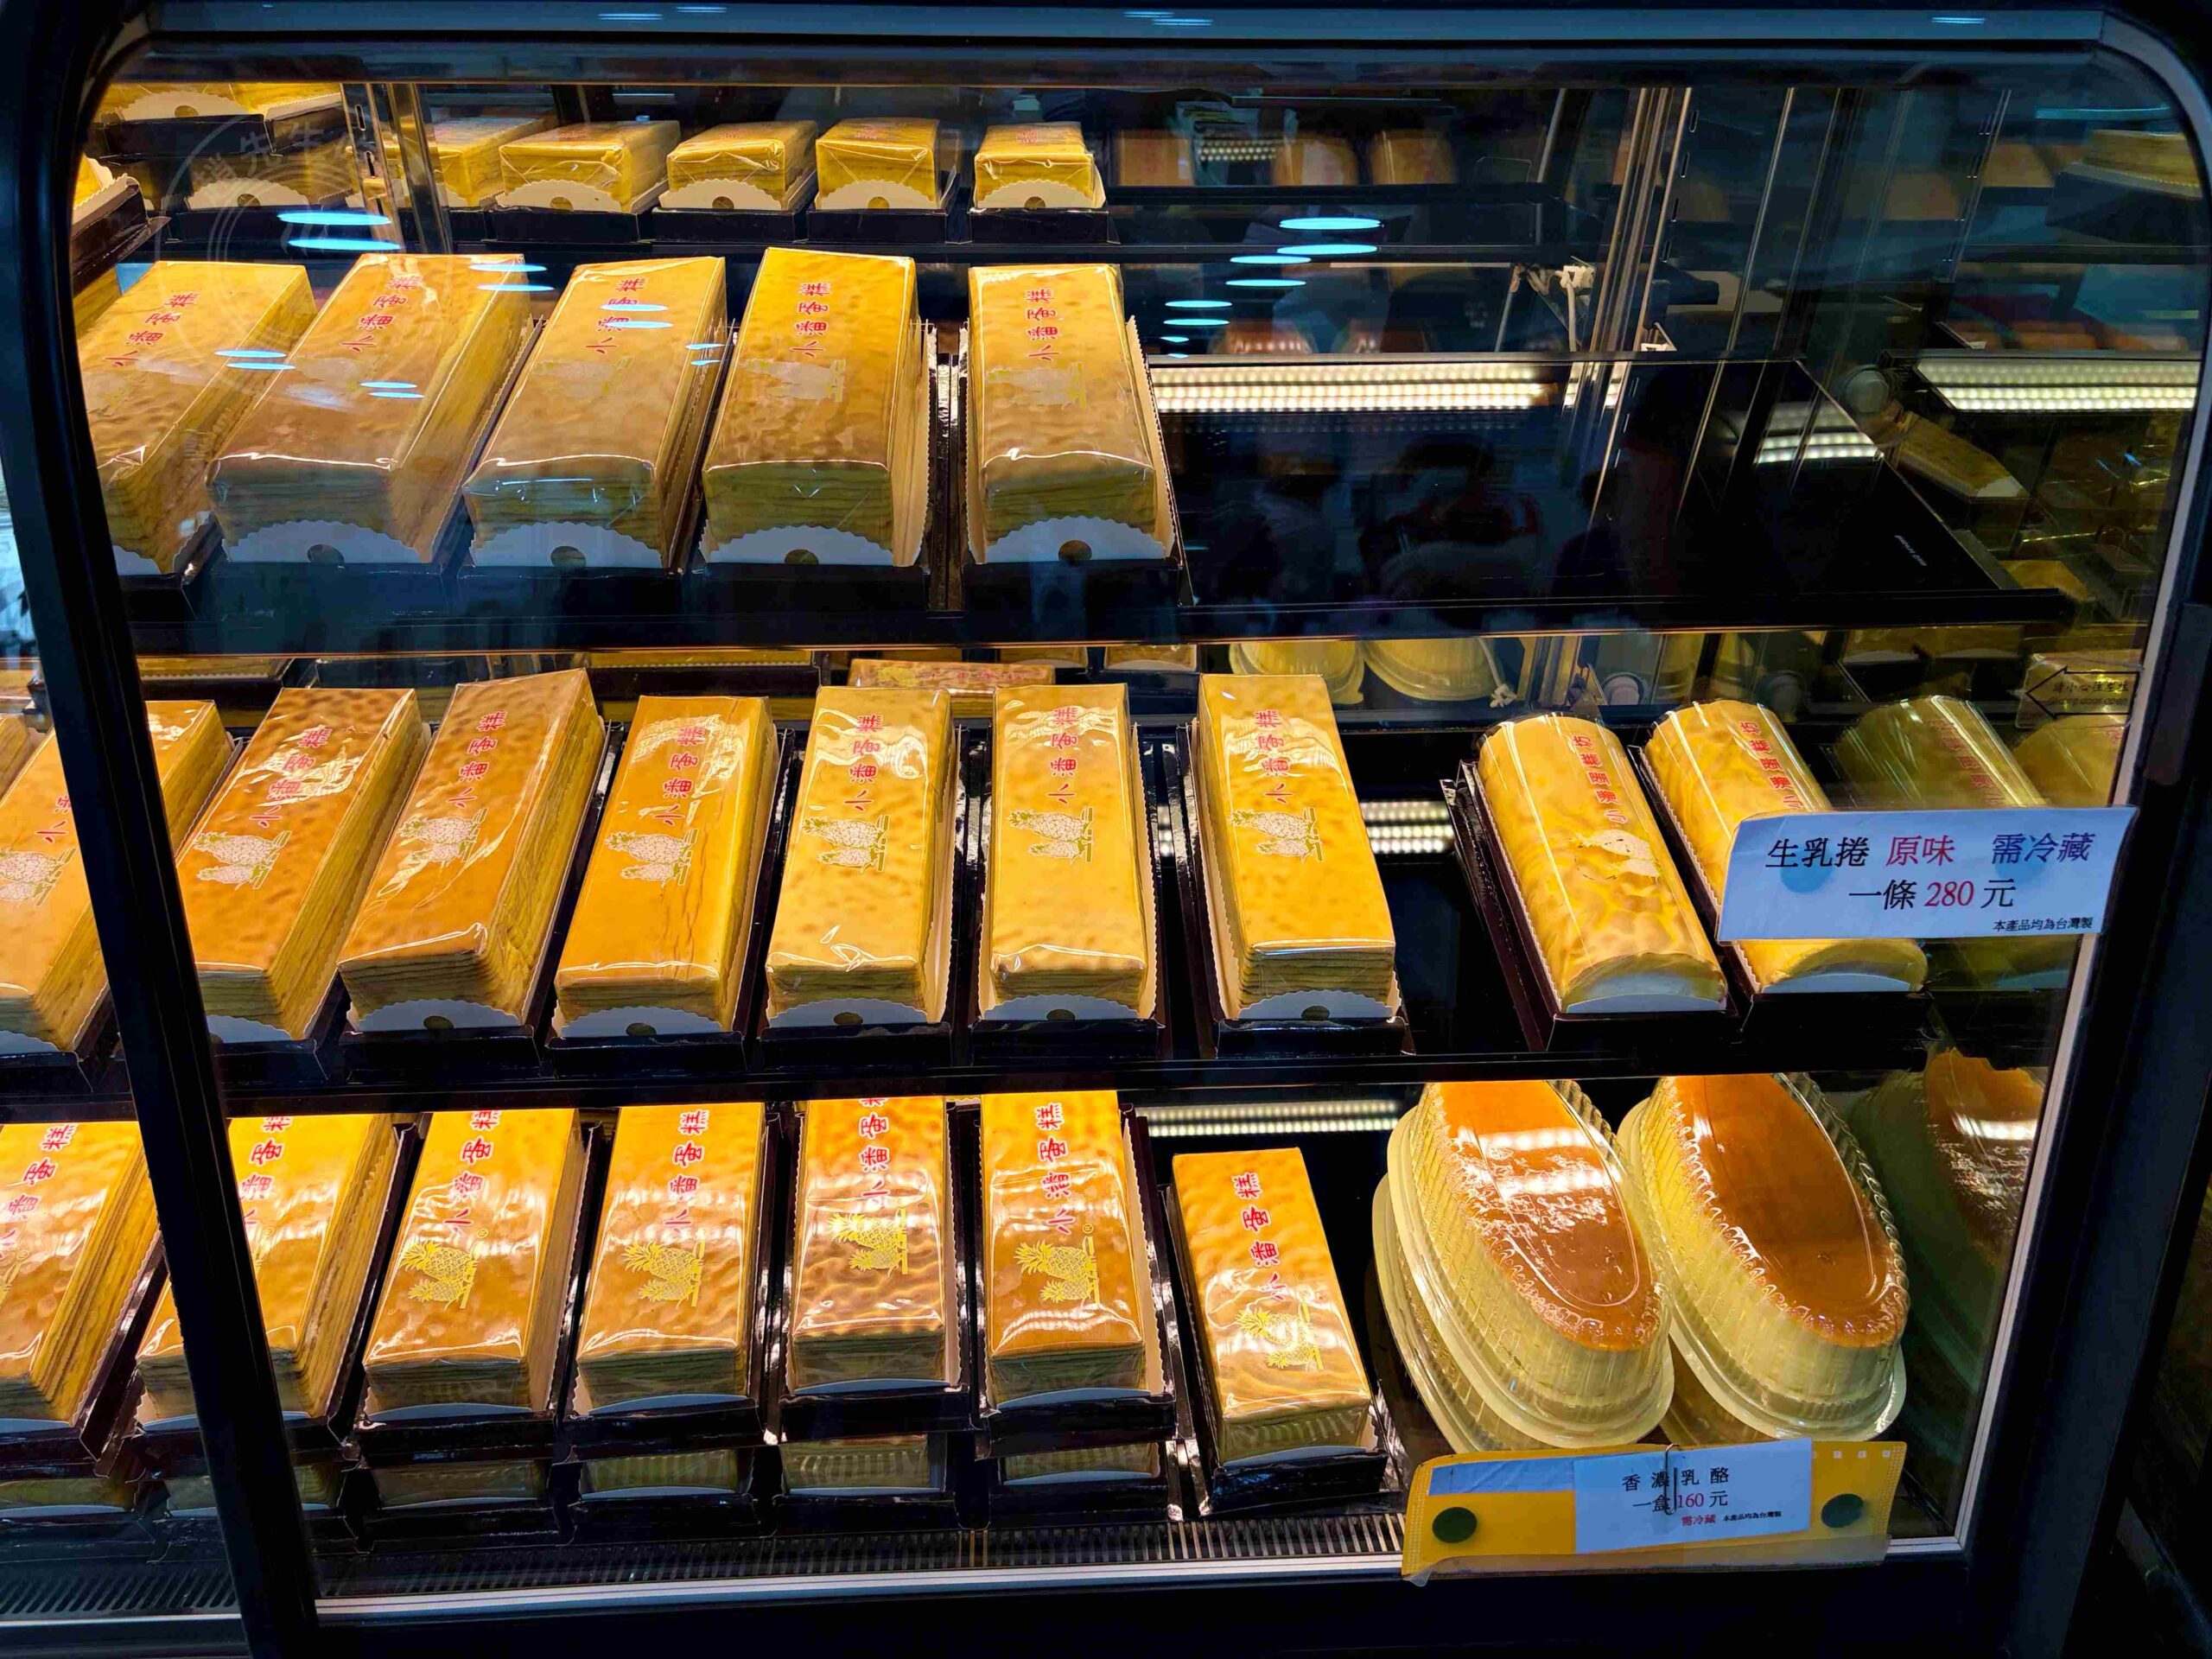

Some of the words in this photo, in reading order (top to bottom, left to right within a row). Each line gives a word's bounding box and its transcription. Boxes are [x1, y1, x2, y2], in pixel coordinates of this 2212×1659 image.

[105, 291, 200, 367] 小潘蛋糕
[340, 274, 423, 352] 小潘蛋糕
[790, 281, 831, 358] 小潘蛋糕
[1025, 287, 1059, 361] 小潘蛋糕
[250, 724, 333, 829] 小潘蛋糕
[447, 709, 507, 809] 小潘蛋糕
[652, 726, 706, 826] 小潘蛋糕
[842, 715, 885, 812] 小潘蛋糕
[1047, 706, 1079, 805] 小潘蛋糕
[1255, 709, 1294, 804] 小潘蛋糕
[1571, 734, 1628, 824] 小潘蛋糕坊
[1740, 720, 1804, 809] 小潘蛋糕坊
[1764, 836, 1870, 868] 生乳捲
[1885, 834, 1955, 867] 原味
[1991, 832, 2096, 865] 需冷藏
[1848, 880, 1916, 910] 一條
[1923, 880, 1974, 907] 280
[1981, 879, 2017, 909] 元
[1993, 917, 2093, 932] 本產品均為台灣製
[664, 1109, 709, 1236] 小潘蛋糕
[1035, 1103, 1076, 1234] 小潘蛋糕
[1234, 1172, 1287, 1300] 小潘蛋糕
[1677, 1492, 1704, 1509] 160
[1709, 1491, 1728, 1508] 元
[1681, 1514, 1716, 1526] 需冷藏
